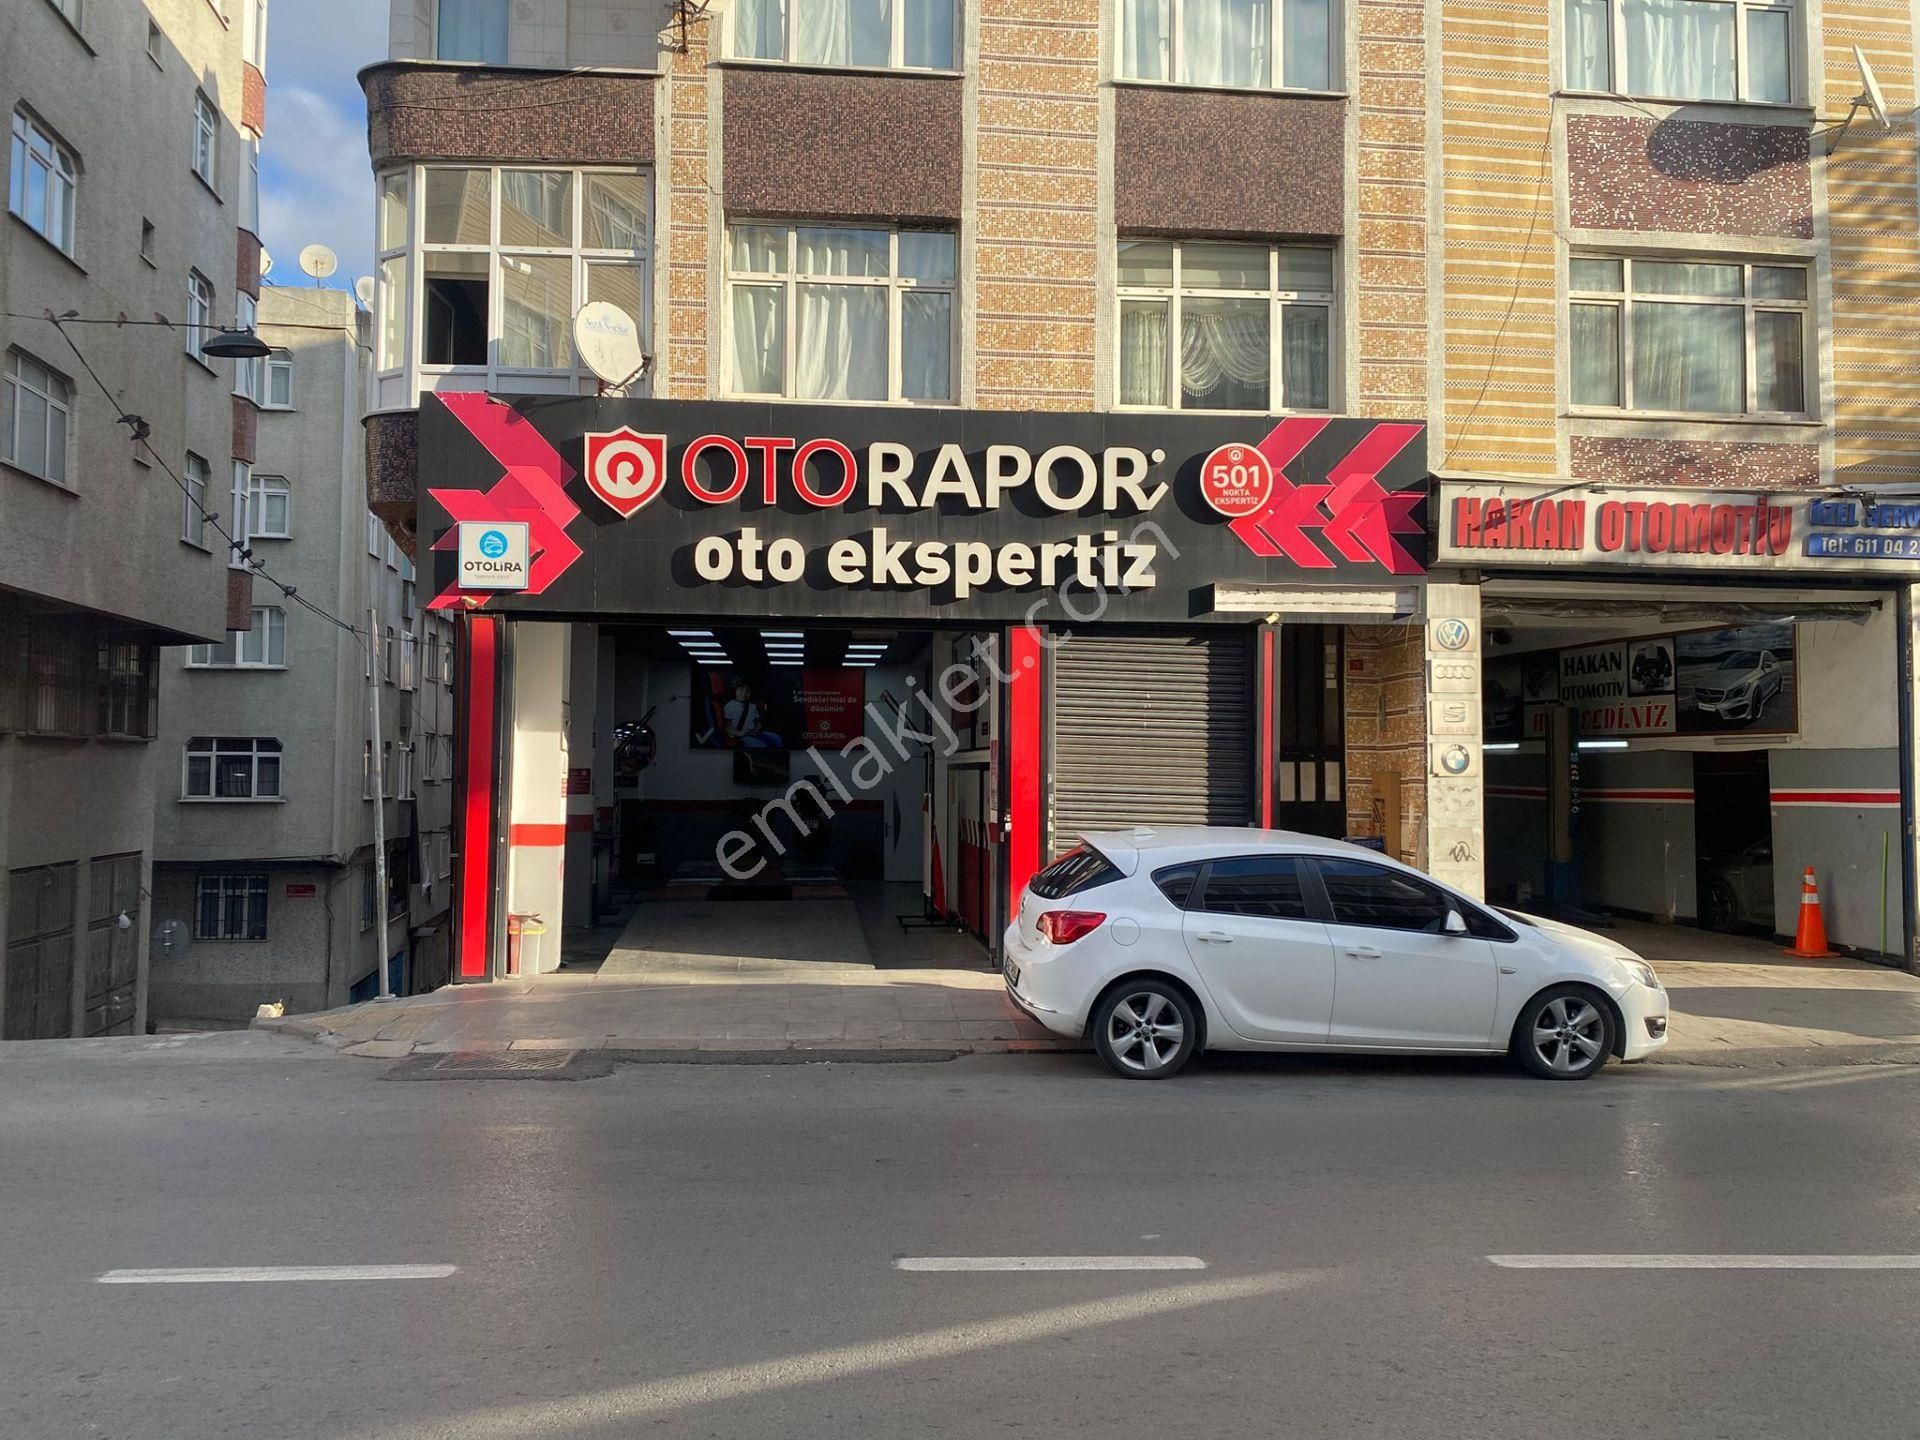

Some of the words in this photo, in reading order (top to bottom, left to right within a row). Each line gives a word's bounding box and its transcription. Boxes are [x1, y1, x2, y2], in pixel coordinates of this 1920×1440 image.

[1212, 465, 1260, 488] 501
[1222, 488, 1251, 497] NOKTA
[1455, 496, 1586, 549] HAKAN
[1600, 496, 1793, 556] OTOMOTİV
[1821, 537, 1849, 553] Tel:
[1854, 538, 1878, 553] 611
[1883, 539, 1904, 554] 04
[694, 527, 805, 582] oto
[827, 527, 1156, 599] ekspertiz
[1563, 650, 1622, 677] HAKAN
[1561, 678, 1625, 700] OTOMOTİV
